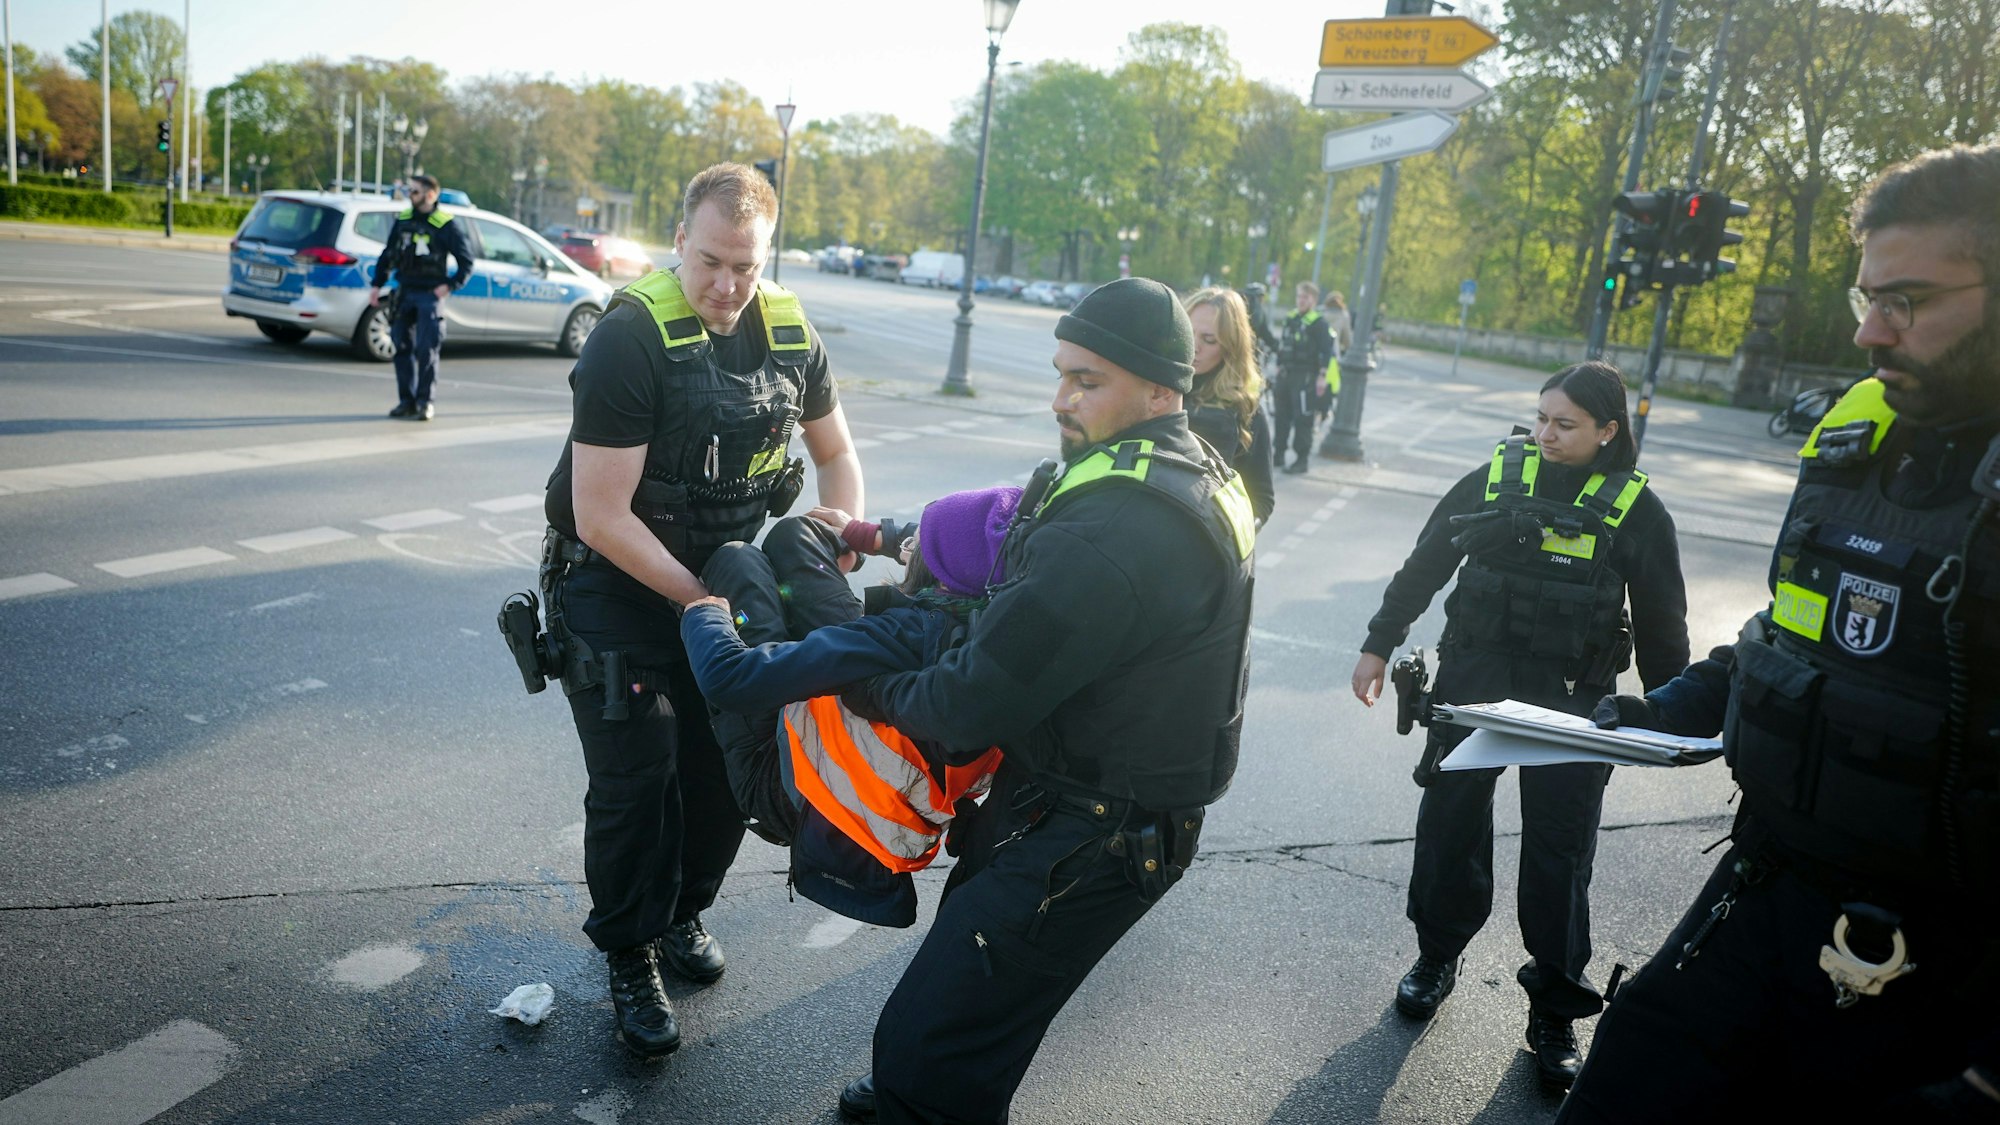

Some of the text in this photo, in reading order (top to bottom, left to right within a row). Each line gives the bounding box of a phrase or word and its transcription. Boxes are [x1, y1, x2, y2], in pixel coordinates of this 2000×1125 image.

[1335, 27, 1430, 44] Schöneberg
[1344, 46, 1428, 64] Kreuzberg
[1360, 82, 1453, 100] Schönefeld
[1370, 134, 1393, 150] Zoo
[510, 282, 560, 299] POLIZEI
[1846, 534, 1883, 554] 32459
[1550, 554, 1572, 565] 25044
[1842, 576, 1899, 604] POLIZEI
[1777, 590, 1823, 631] POLIZEI
